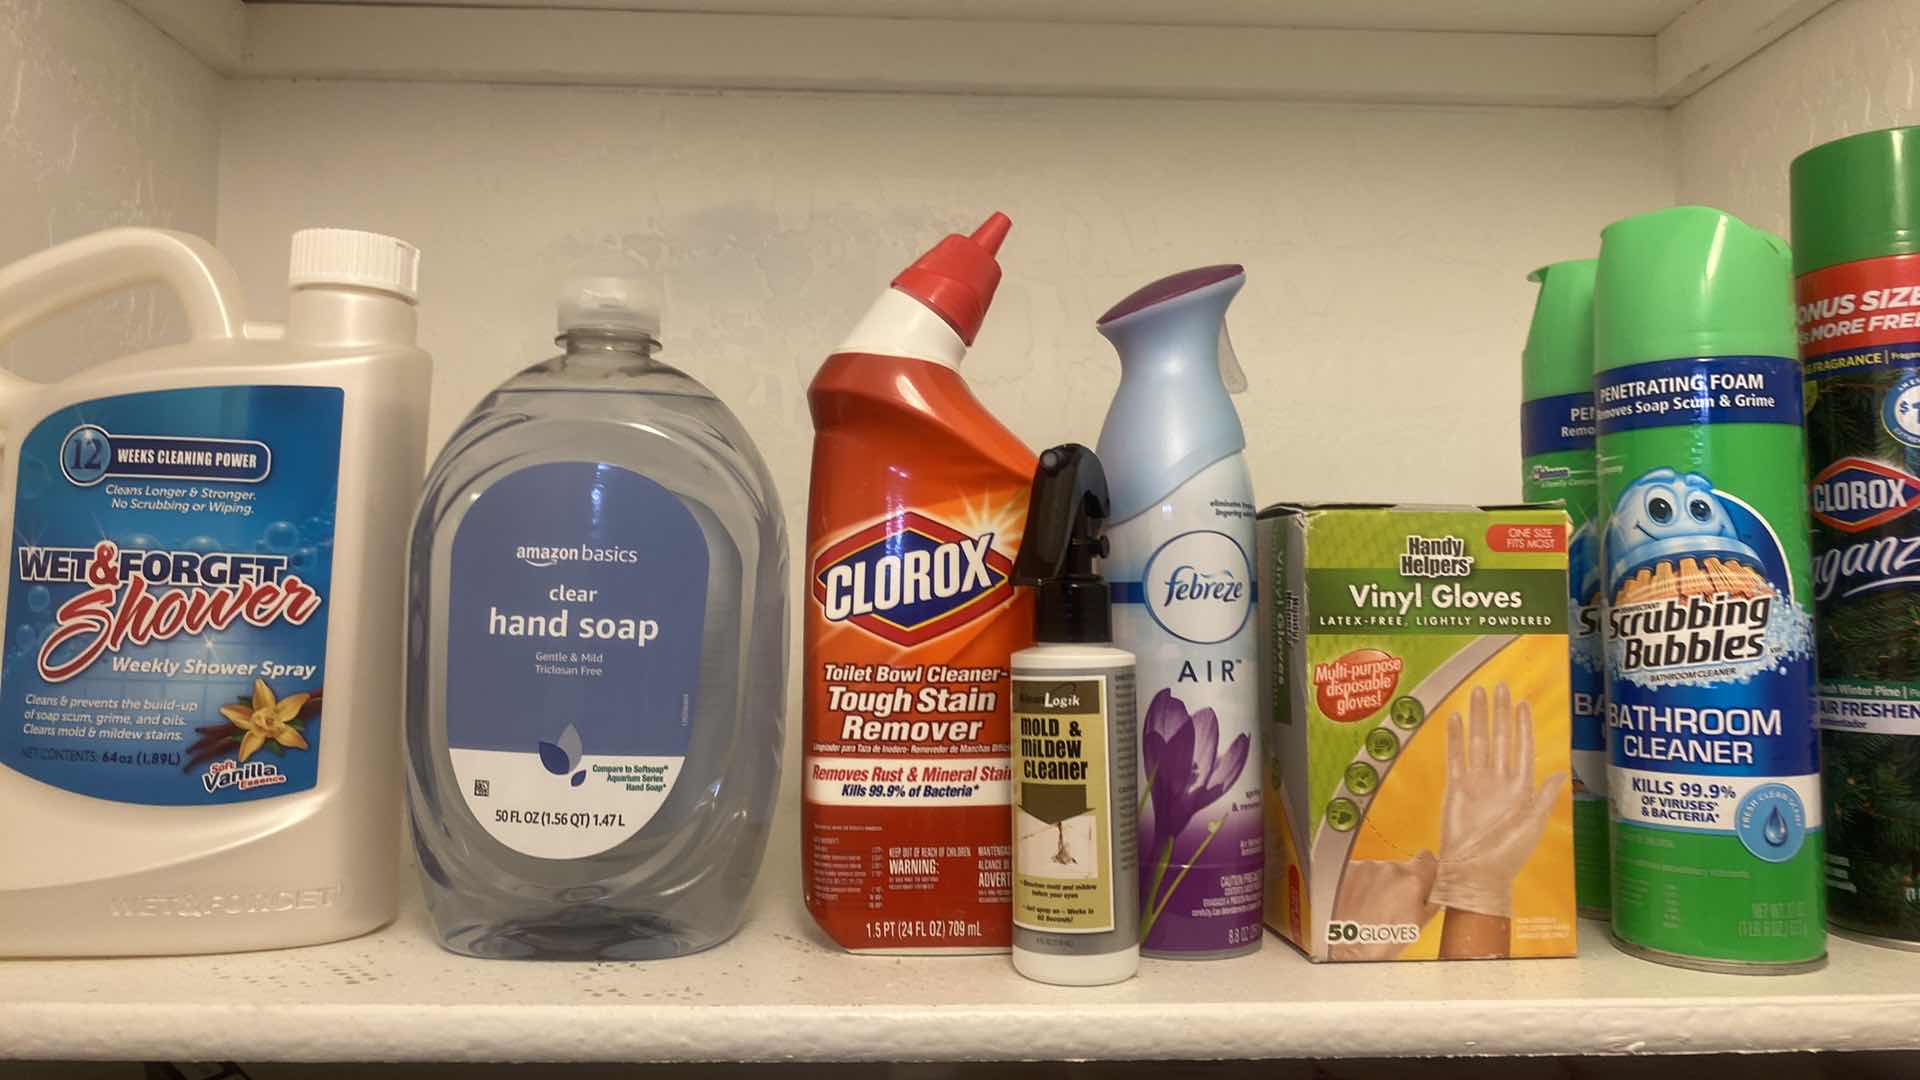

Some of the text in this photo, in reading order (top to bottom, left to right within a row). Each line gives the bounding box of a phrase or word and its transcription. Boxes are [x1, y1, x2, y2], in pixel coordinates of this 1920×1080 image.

[1799, 286, 1920, 325] ONUS SIZE
[1810, 317, 1866, 343] MORE
[1599, 373, 1764, 404] PENETRATING FOAM
[1635, 401, 1670, 415] Soap
[1673, 396, 1716, 409] Scum
[1719, 394, 1732, 407] &
[1735, 394, 1776, 408] Grime
[1561, 426, 1596, 438] Remo
[69, 438, 257, 471] 12 WEEKS CLEANING POWER
[105, 483, 256, 501] Cleans Longer & Stronger.
[1813, 479, 1908, 512] CLOROX
[112, 498, 255, 516] No Scrubbing or Wiping.
[1508, 527, 1553, 538] ONE SIZE
[1408, 536, 1464, 557] Handy
[1507, 539, 1555, 549] FITS MOST
[516, 544, 638, 566] amazon basics
[1400, 555, 1471, 577] Helpers
[824, 532, 995, 622] CLOROX
[1164, 564, 1244, 608] febreze
[549, 583, 598, 602] clear
[1349, 583, 1523, 615] Vinyl Gloves
[489, 606, 660, 647] hand soap
[1320, 615, 1552, 627] LATEX-FREE, LIGHTLY POWDERED
[1608, 594, 1773, 640] Scrubbing
[38, 575, 322, 682] Shower
[535, 651, 604, 664] Gentle & Mild
[1624, 629, 1765, 671] Bubbles
[112, 655, 317, 680] Weekly Shower Spray
[535, 664, 603, 676] Triclosan Free
[824, 663, 1008, 683] Toilet Bowl Cleaner-
[1315, 657, 1402, 684] Multi-purpose
[1326, 675, 1392, 698] disposable
[25, 693, 59, 706] Cleans
[69, 696, 121, 711] prevents
[121, 698, 141, 710] the
[144, 699, 198, 713] build-up
[828, 685, 998, 718] Tough Stain
[1336, 691, 1382, 716] gloves!
[1841, 702, 1920, 719] FRESHEN
[24, 710, 35, 721] of
[36, 712, 61, 724] soap
[136, 714, 160, 725] and
[841, 713, 984, 742] Remover
[1608, 702, 1783, 736] BATHROOM
[23, 723, 185, 742] Cleans mold & mildew stains.
[1069, 720, 1082, 737] &
[136, 752, 181, 767] (1.89L)
[1624, 735, 1753, 764] CLEANER
[210, 760, 236, 774] Soft
[592, 764, 624, 775] Compare
[812, 764, 1012, 783] Removes Rust & Mineral Stai
[202, 762, 278, 793] Vanilla
[625, 783, 645, 792] Hand
[642, 774, 664, 783] Series
[842, 784, 867, 797] Kills
[868, 784, 906, 798] 99.9%
[908, 784, 920, 798] of
[1632, 776, 1737, 800] KILLS 99.9%
[1641, 795, 1656, 806] OF
[495, 809, 626, 829] 50 FL OZ (1.56 QT) 1.47 L
[1641, 806, 1649, 817] &
[889, 859, 940, 875] WARNING:
[978, 872, 1011, 888] ADVERT
[866, 920, 982, 940] 1.5 PT (24 FL OZ) 709 mL
[1327, 922, 1418, 942] 50 GLOVES
